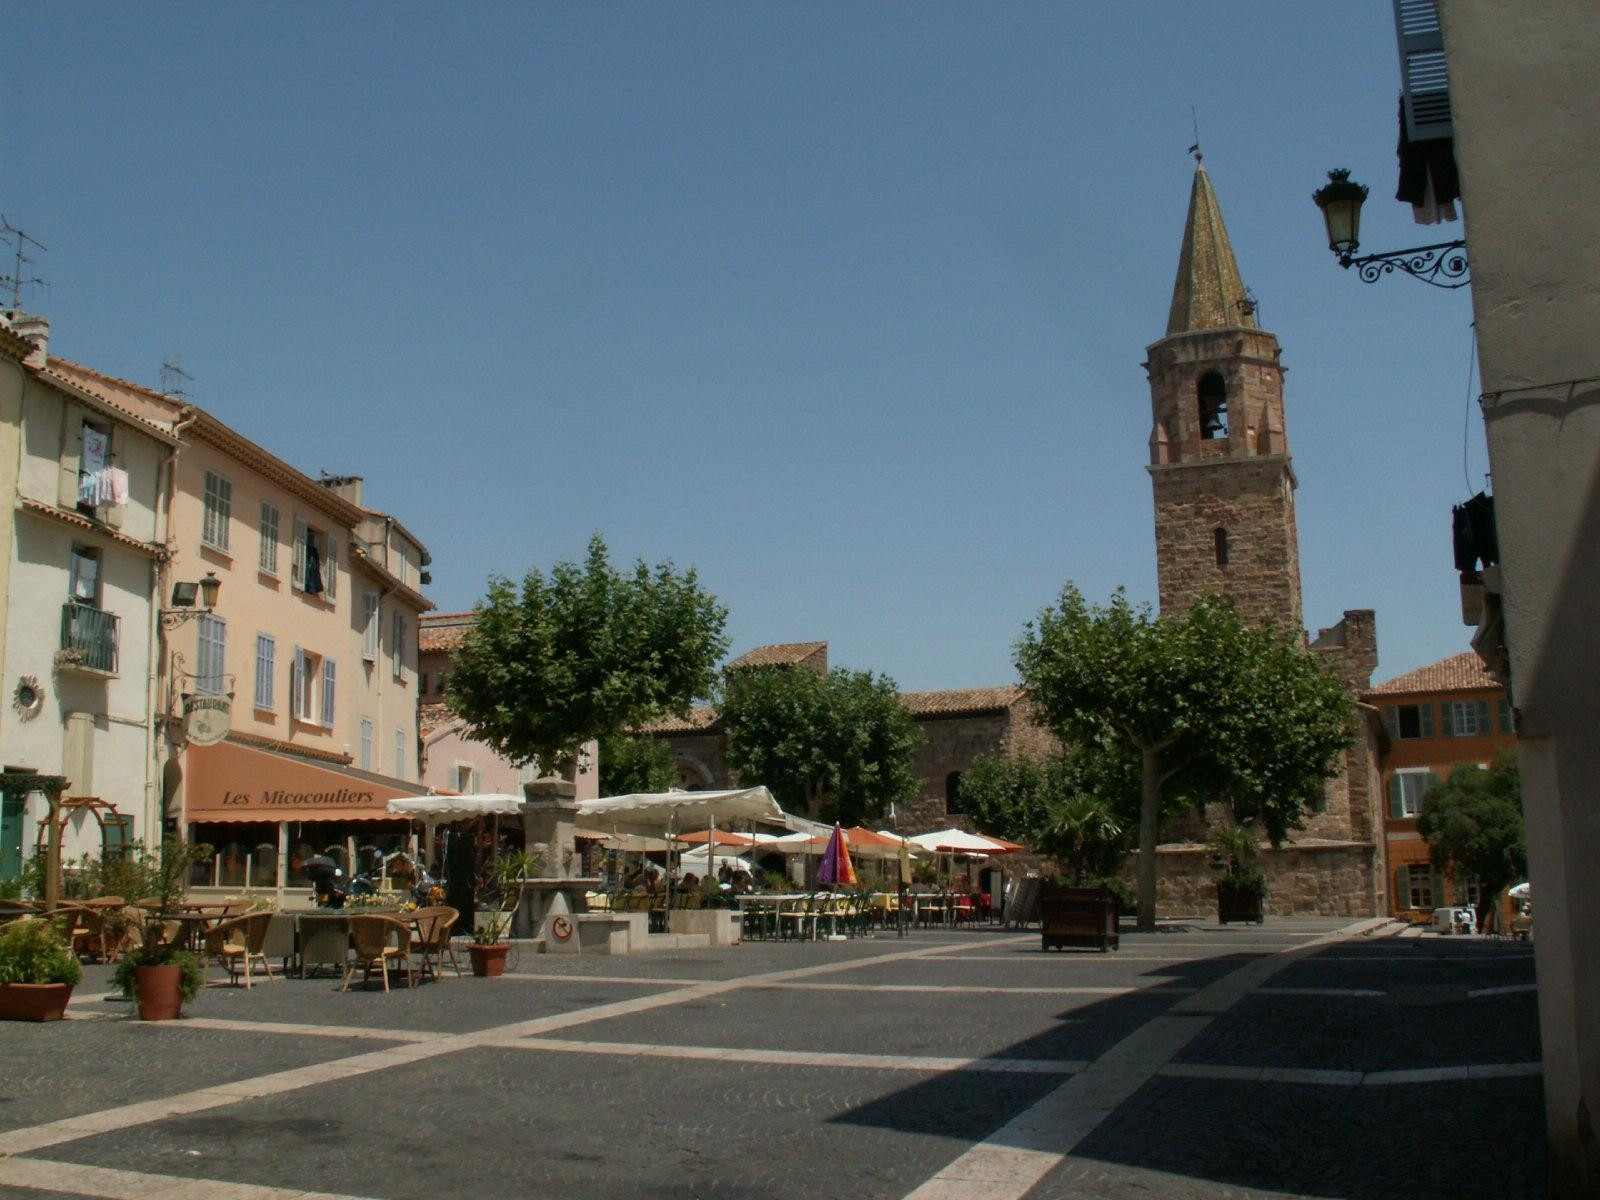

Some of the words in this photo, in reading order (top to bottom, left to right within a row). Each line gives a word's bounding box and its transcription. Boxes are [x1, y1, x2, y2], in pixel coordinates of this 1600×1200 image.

[185, 698, 229, 714] RESTAURANT
[223, 791, 250, 805] Les
[260, 788, 374, 805] Micocouliers
